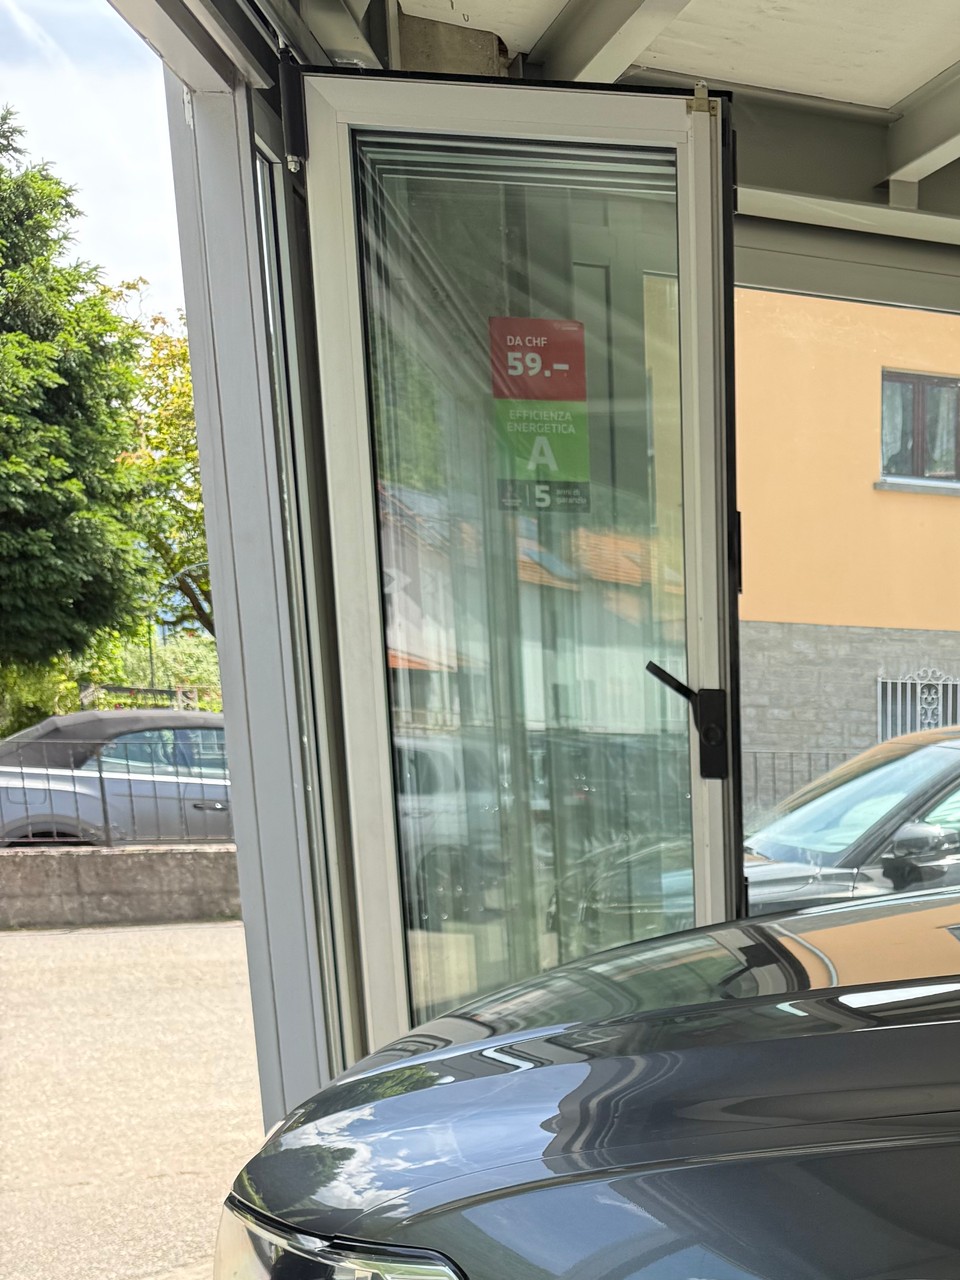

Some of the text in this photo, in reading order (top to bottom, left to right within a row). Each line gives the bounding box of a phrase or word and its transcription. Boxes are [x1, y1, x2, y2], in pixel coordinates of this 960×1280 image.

[506, 335, 548, 347] DA CHF
[509, 409, 573, 421] EFFICIENZA
[506, 422, 576, 434] ENERGETICA
[527, 436, 558, 471] A
[535, 485, 551, 508] 5
